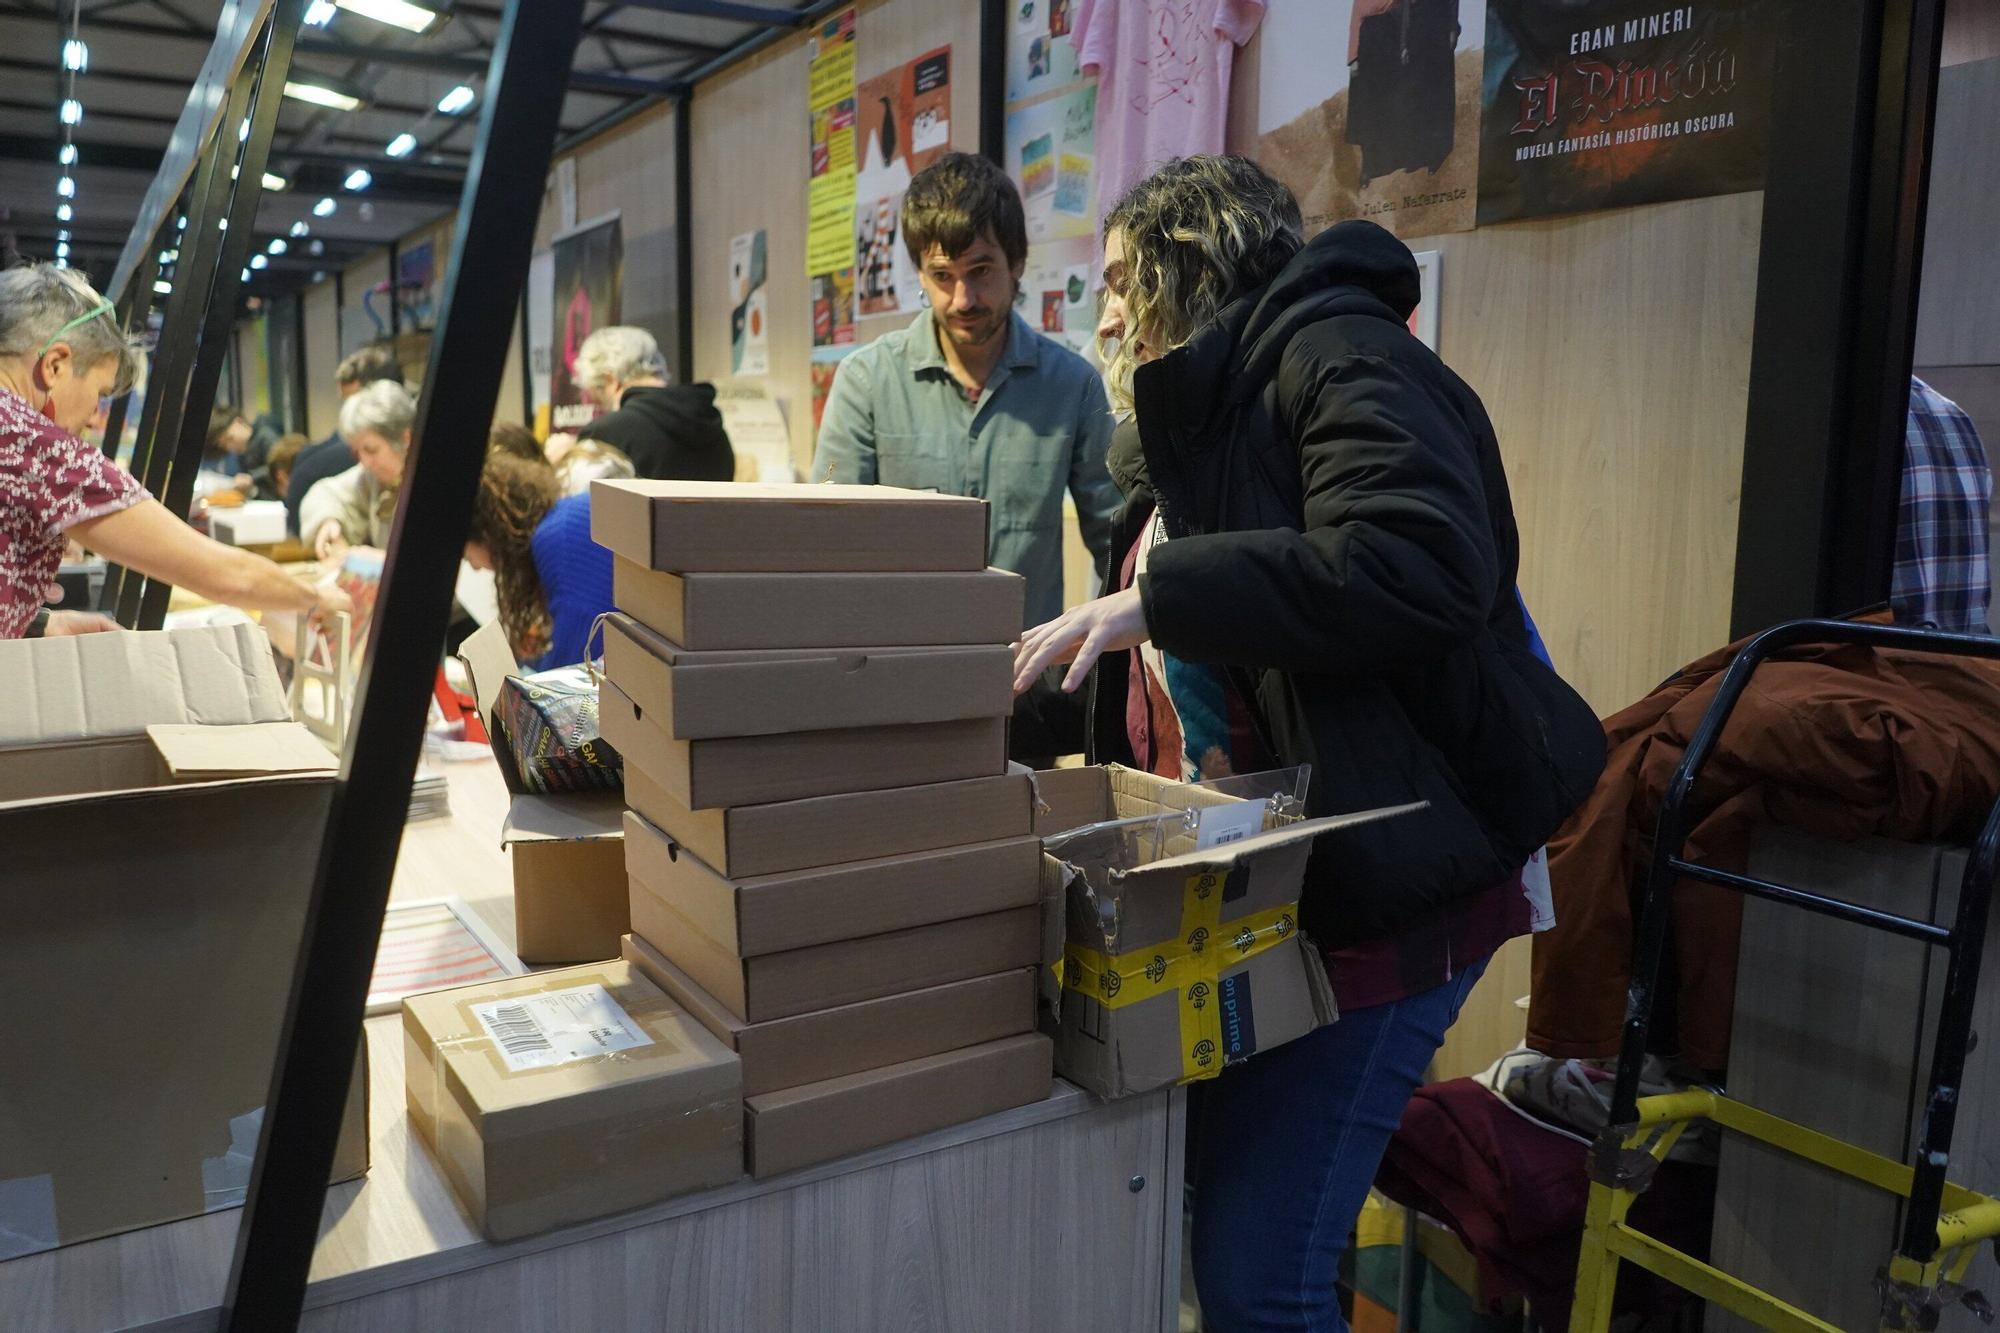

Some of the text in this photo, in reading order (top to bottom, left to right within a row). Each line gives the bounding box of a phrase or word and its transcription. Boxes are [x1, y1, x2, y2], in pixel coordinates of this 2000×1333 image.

[1570, 6, 1693, 55] ERAN MINERI
[1510, 72, 1559, 135] El
[1515, 111, 1734, 161] NOVELA FANTASÍA HISTÓRICA OSCURA
[1403, 188, 1467, 209] Nafarrate
[1224, 999, 1240, 1052] prime
